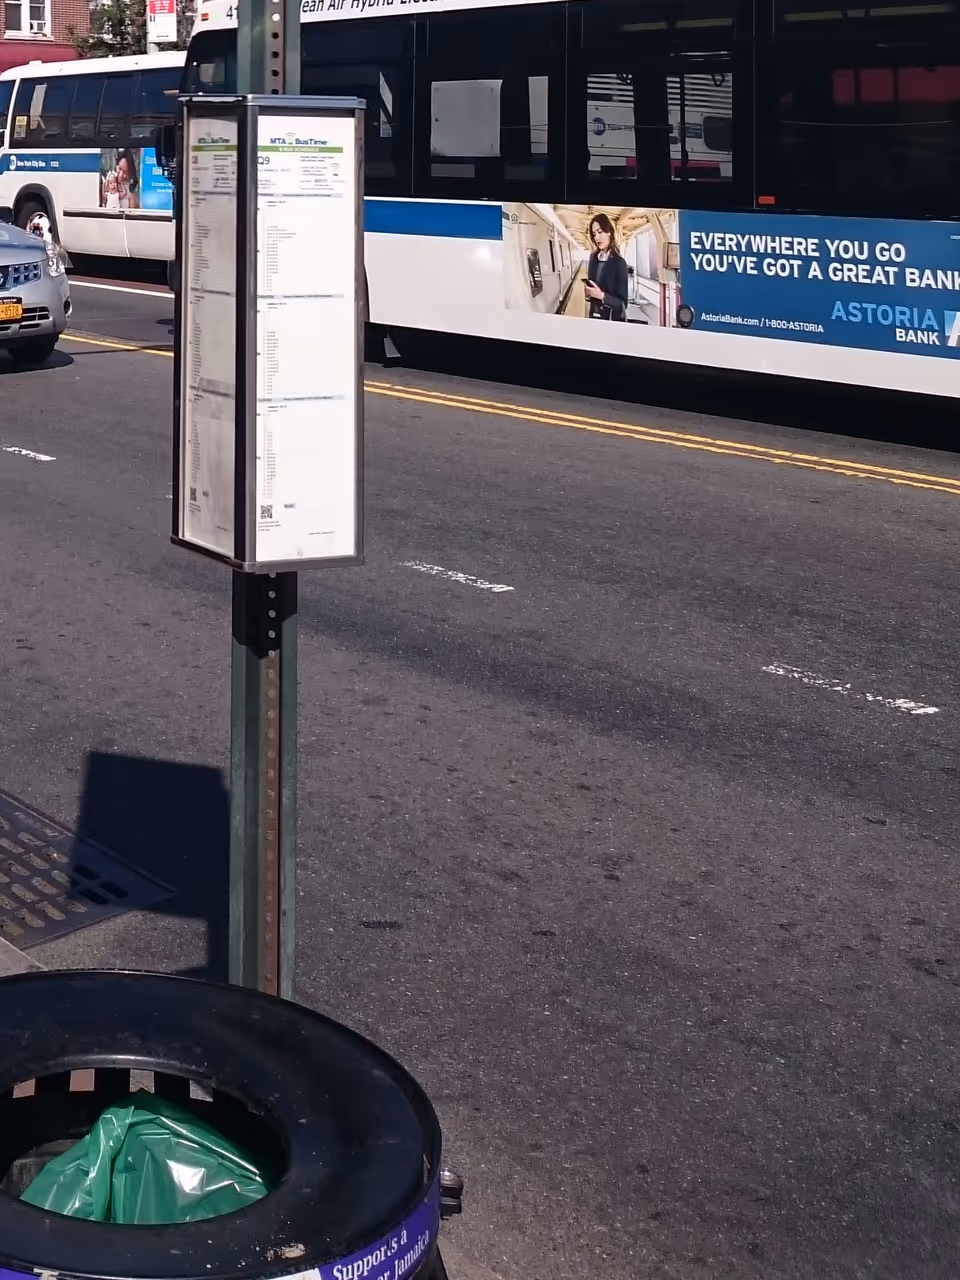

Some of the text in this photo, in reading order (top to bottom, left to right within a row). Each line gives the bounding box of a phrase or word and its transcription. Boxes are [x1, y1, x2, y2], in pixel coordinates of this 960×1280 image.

[270, 137, 287, 145] MTA
[257, 156, 270, 165] Q9
[690, 231, 906, 263] EVERYWHERE YOU GO
[690, 253, 758, 275] YOU'VE
[763, 259, 802, 278] GOT
[808, 262, 823, 280] A
[829, 263, 898, 285] GREAT
[701, 312, 759, 327] AstoriaBank.com
[765, 319, 824, 333] 1-800-ASTORIA
[831, 300, 940, 330] ASTORIA
[895, 328, 940, 346] BANK
[400, 1229, 408, 1246] a
[393, 1230, 429, 1280] Jamaica
